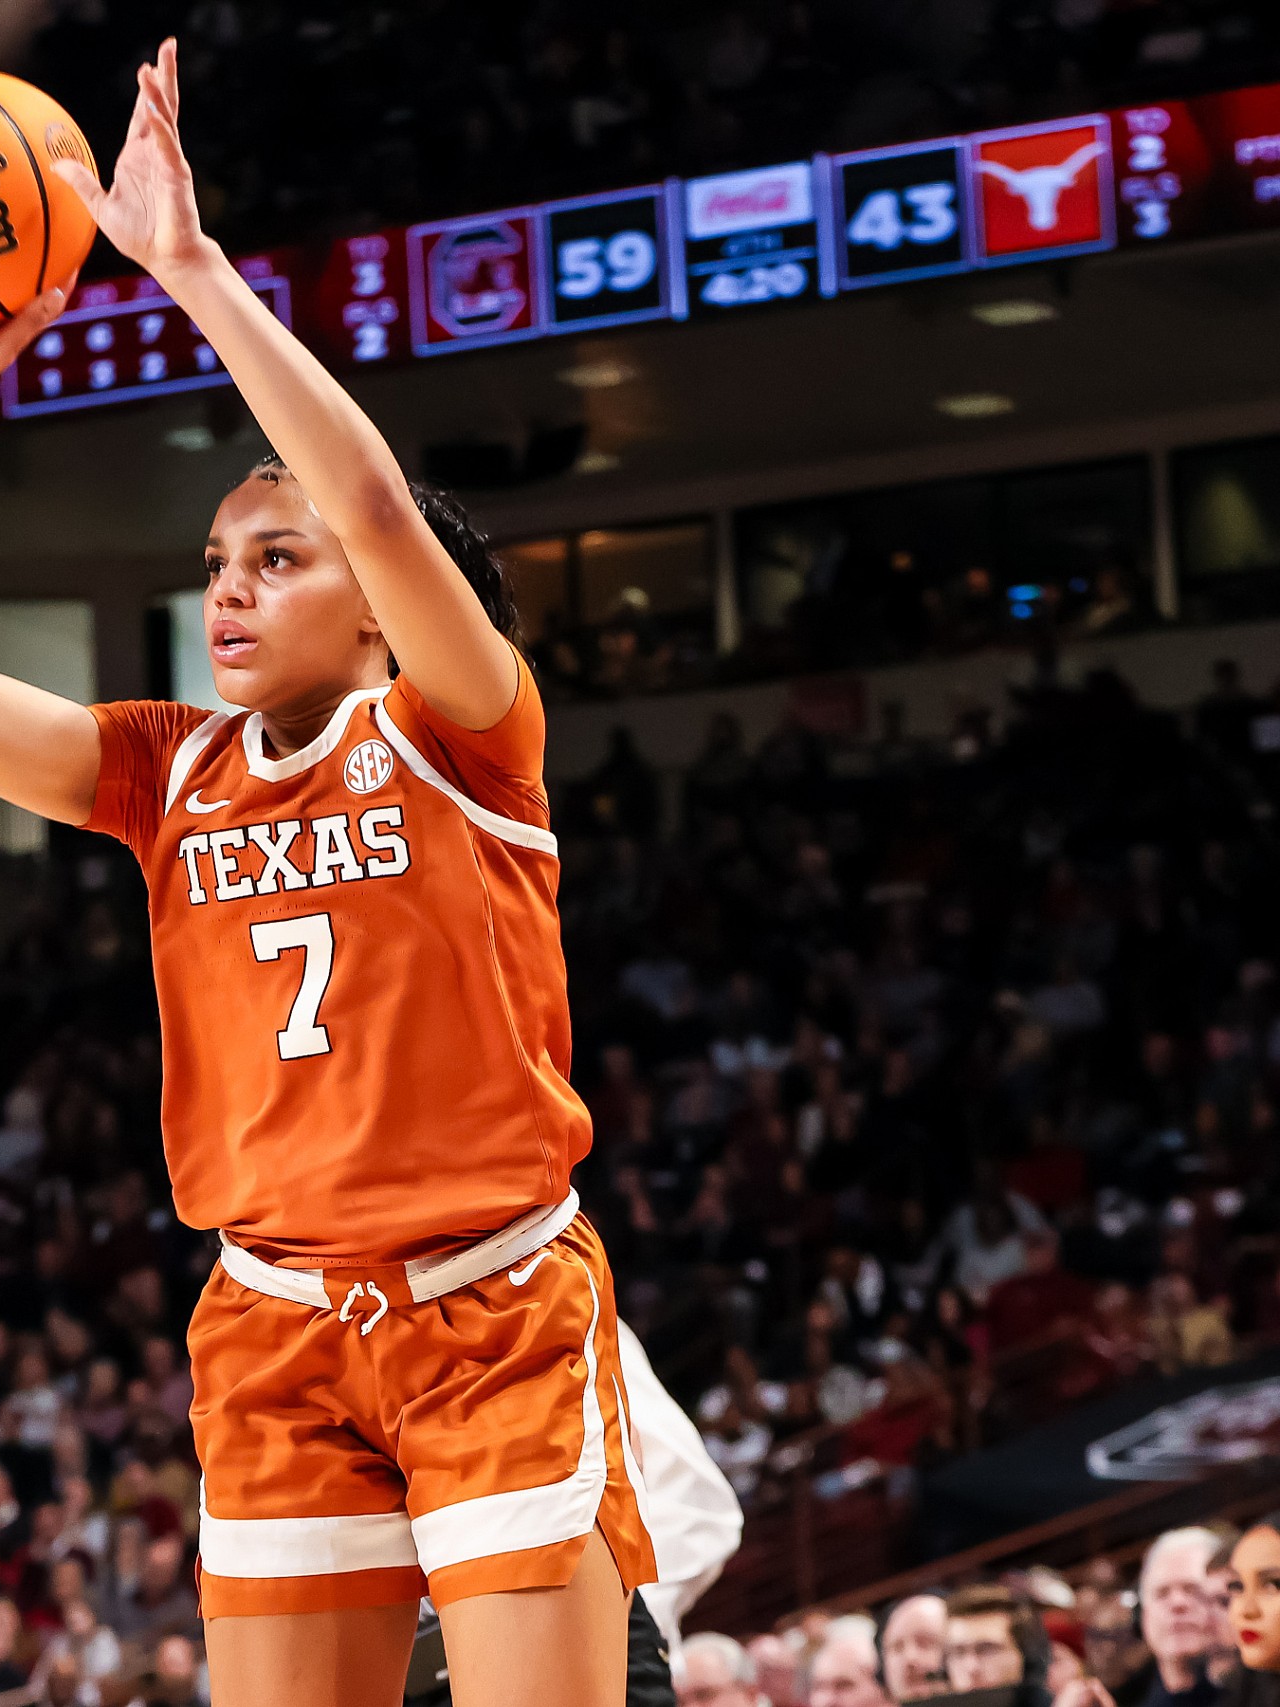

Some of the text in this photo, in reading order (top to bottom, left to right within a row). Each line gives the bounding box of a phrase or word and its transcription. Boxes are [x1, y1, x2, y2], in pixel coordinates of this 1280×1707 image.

[1129, 134, 1166, 171] 2
[847, 181, 957, 251] 43
[1134, 202, 1170, 238] 3
[558, 230, 657, 299] 59
[353, 325, 388, 361] 2
[346, 743, 390, 791] SEC
[178, 806, 412, 905] TEXAS
[250, 912, 335, 1061] 7
